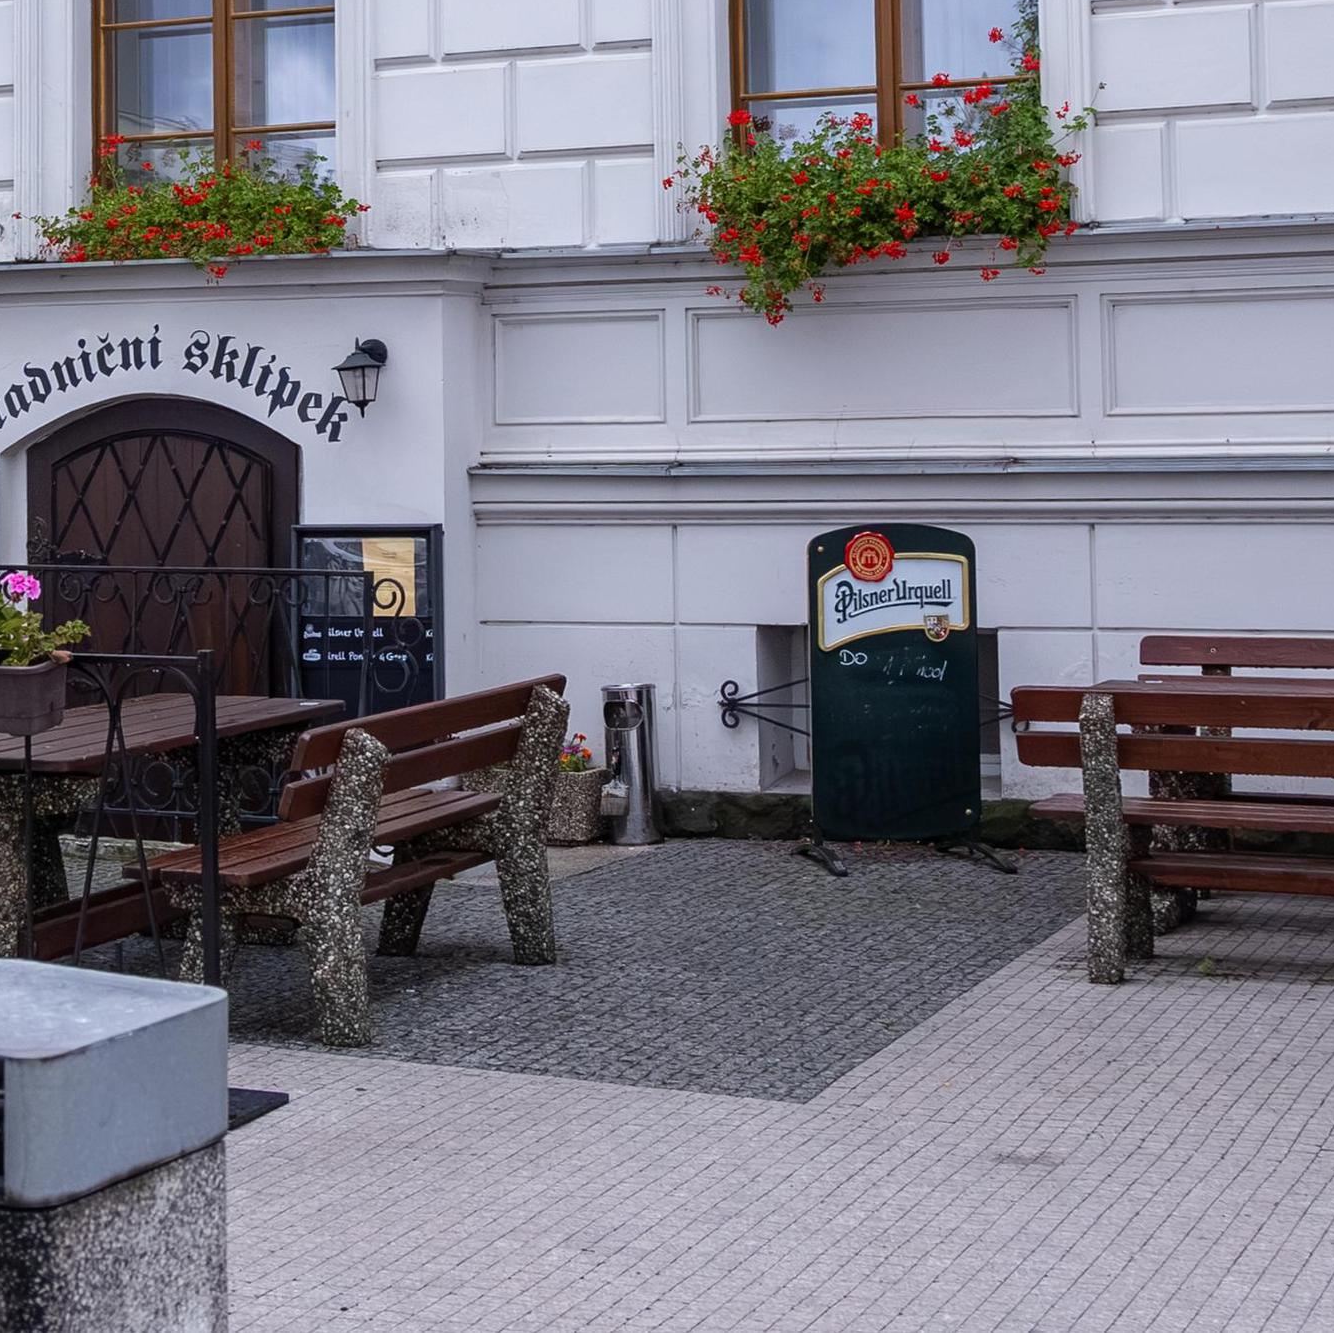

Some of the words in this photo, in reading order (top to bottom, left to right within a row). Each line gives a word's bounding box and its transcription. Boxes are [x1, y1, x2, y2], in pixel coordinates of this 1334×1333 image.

[834, 579, 895, 624] Pilsner
[892, 578, 952, 609] Urquell
[328, 627, 352, 637] ilsner
